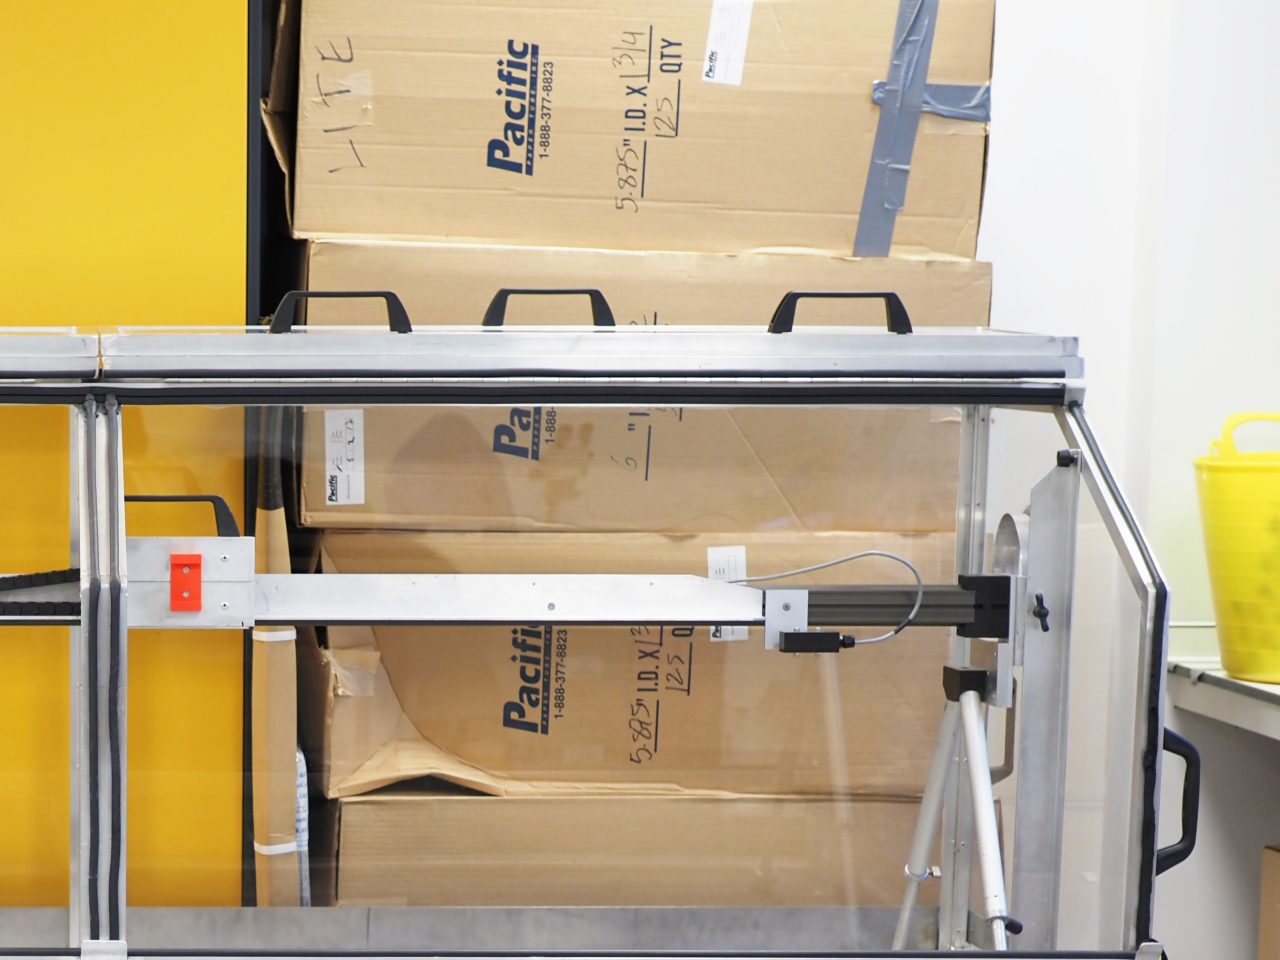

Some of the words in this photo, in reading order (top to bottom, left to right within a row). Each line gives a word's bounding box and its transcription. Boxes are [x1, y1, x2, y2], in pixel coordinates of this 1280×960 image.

[659, 38, 683, 73] QTY
[705, 50, 717, 78] Pacific
[625, 84, 648, 97] X
[486, 39, 529, 174] Pacific
[538, 61, 554, 159] 1-888-377-8823
[623, 102, 647, 132] I.D.
[328, 474, 337, 502] Pacific
[638, 649, 661, 660] X
[502, 625, 542, 734] Pacifi
[554, 629, 568, 720] 1-888-377-8823
[637, 665, 659, 692] I.D.
